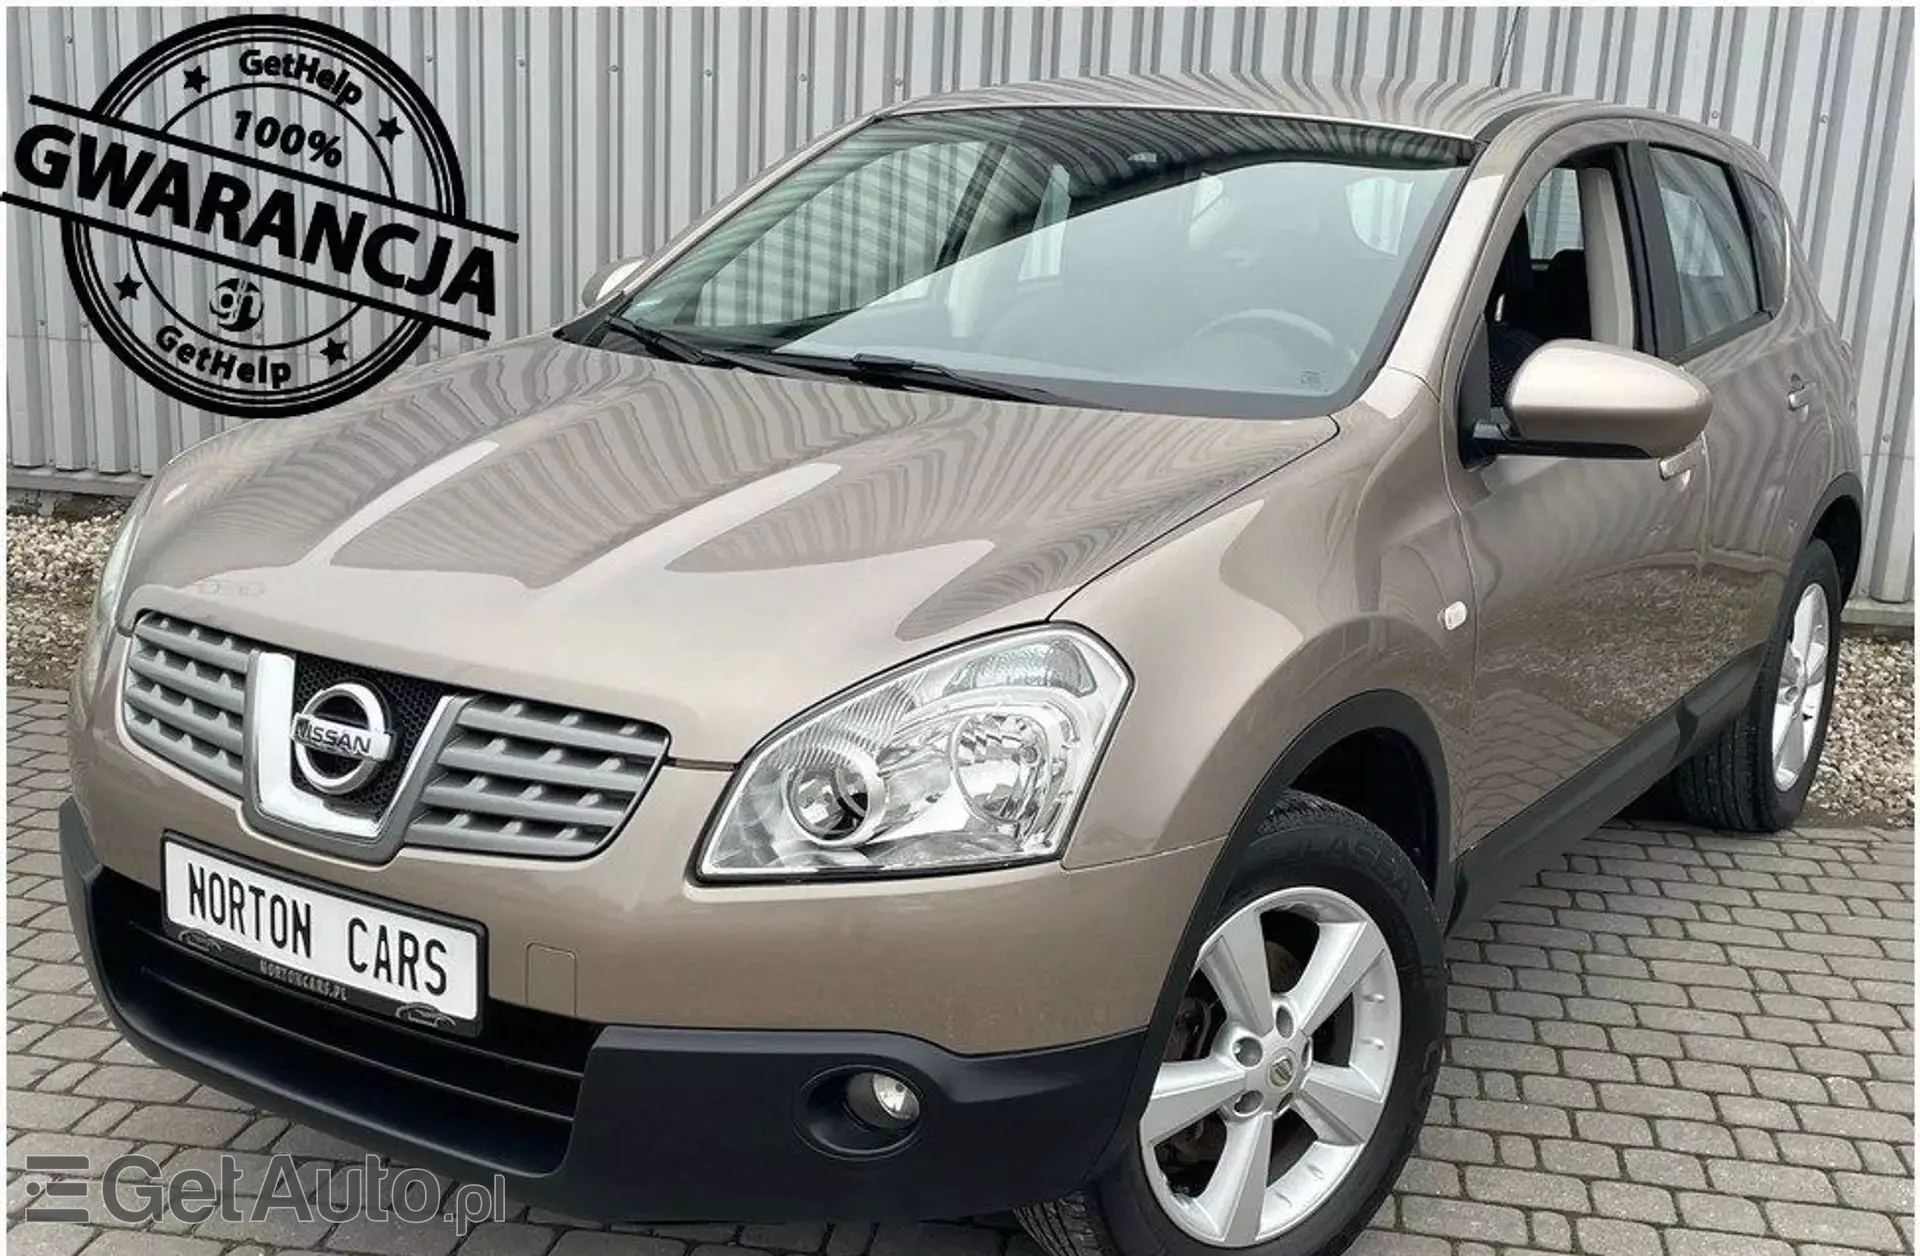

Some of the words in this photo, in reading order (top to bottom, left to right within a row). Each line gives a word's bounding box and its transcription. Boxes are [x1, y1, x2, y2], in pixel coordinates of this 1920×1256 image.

[294, 717, 372, 755] NISSAN
[188, 863, 311, 958] NORTON
[348, 917, 447, 996] CARS
